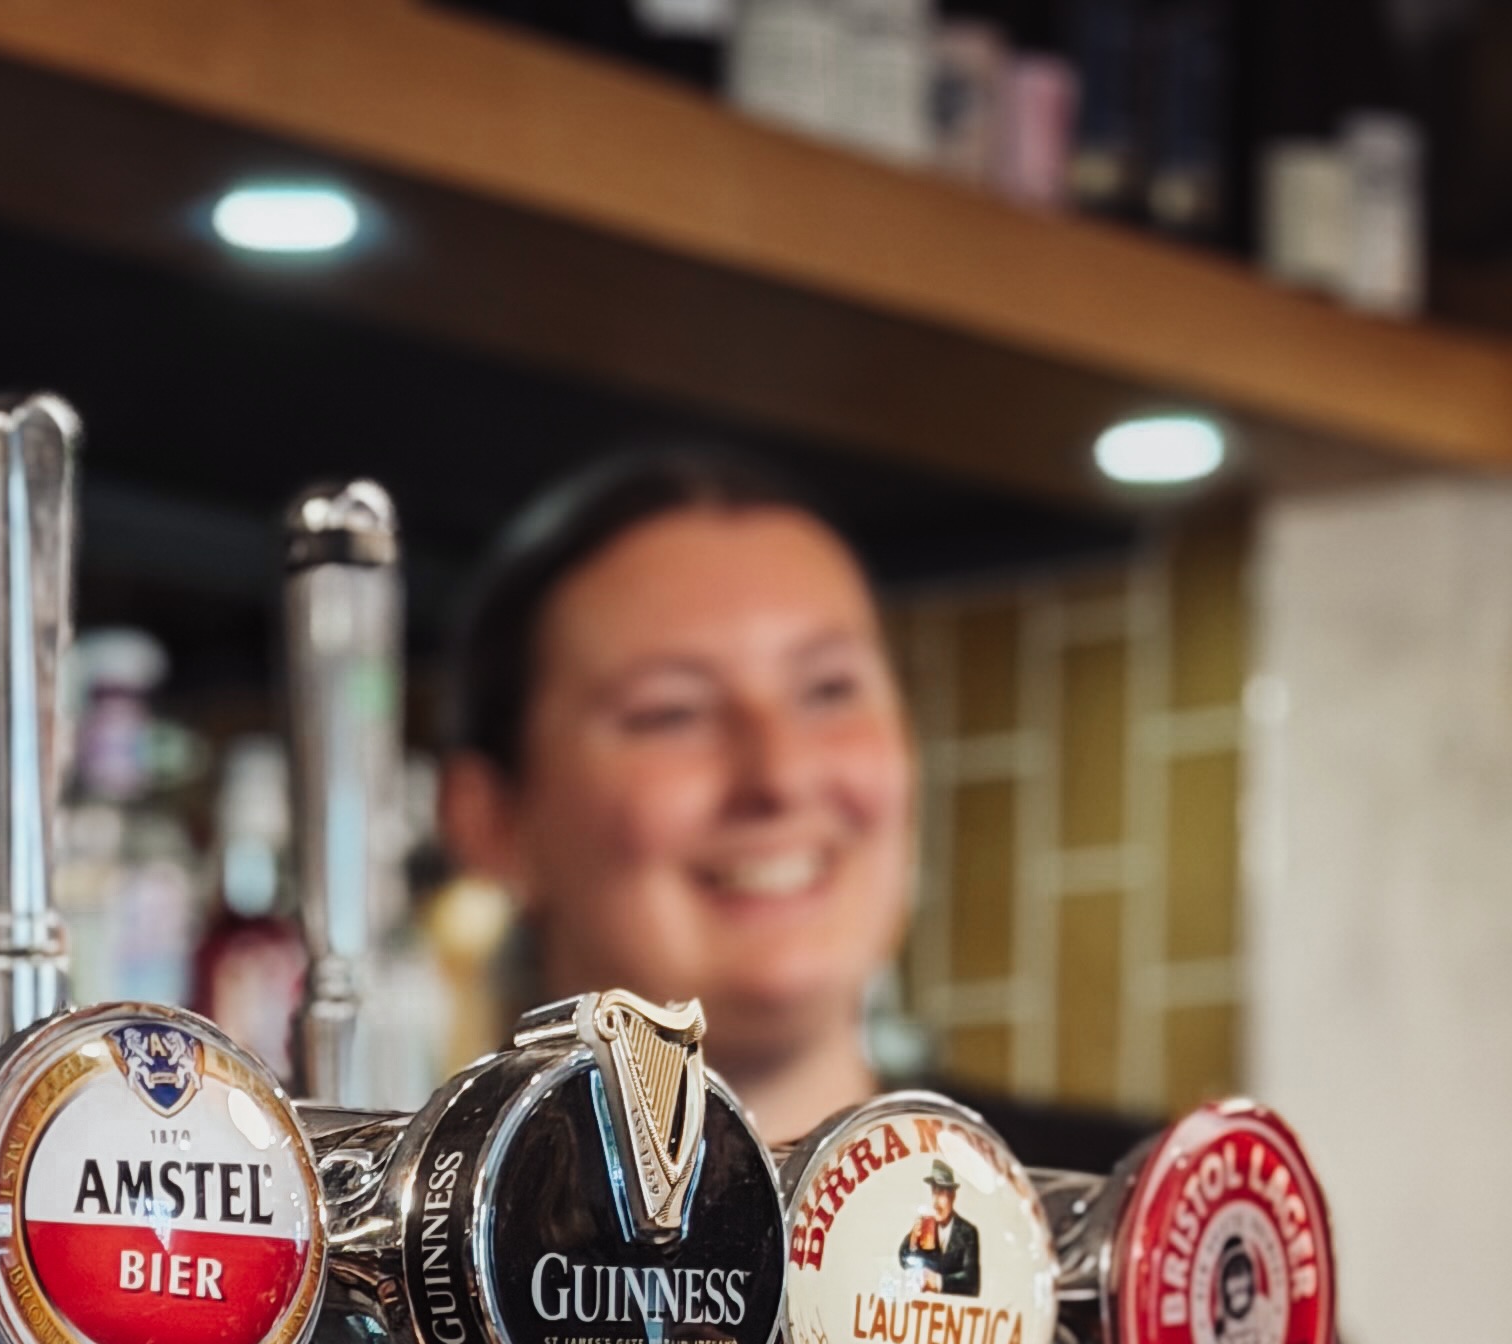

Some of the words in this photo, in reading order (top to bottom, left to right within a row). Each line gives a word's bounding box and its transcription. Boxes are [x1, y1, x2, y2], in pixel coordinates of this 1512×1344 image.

[150, 1032, 168, 1057] A
[73, 1157, 275, 1225] AMSTEL
[788, 1122, 911, 1272] BIRRA
[1159, 1141, 1244, 1328] BRISTOL
[1246, 1141, 1319, 1303] LAGER
[118, 1248, 224, 1300] BIER
[530, 1252, 749, 1326] GUINNESS
